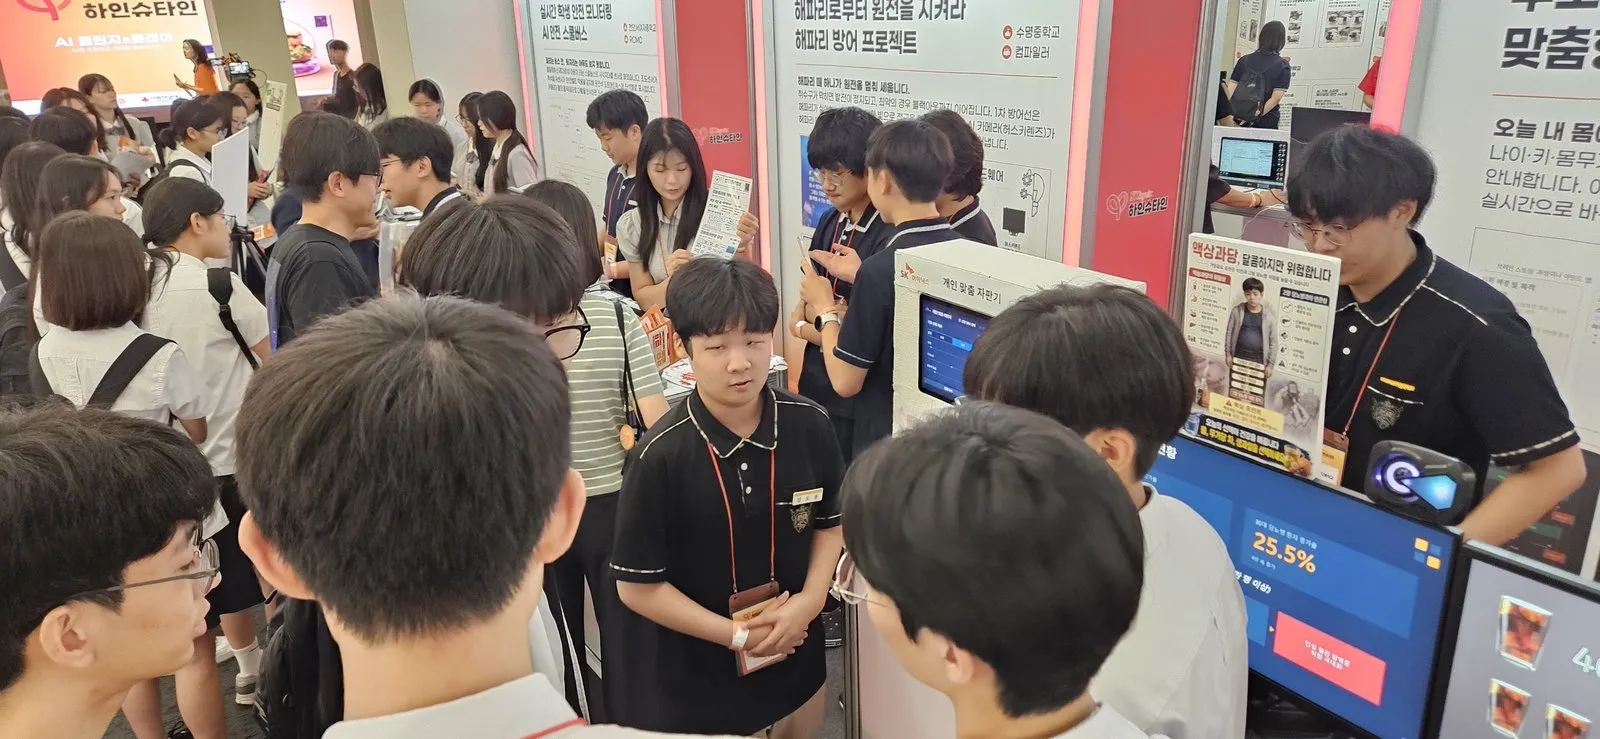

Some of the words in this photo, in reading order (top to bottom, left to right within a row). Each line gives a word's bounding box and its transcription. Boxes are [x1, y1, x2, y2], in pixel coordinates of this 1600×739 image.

[83, 0, 198, 18] 하인슈타인
[540, 4, 556, 20] 실시간
[557, 4, 571, 20] 학생
[571, 4, 584, 20] 안전
[586, 4, 612, 20] 모니터링
[795, 0, 867, 21] 해파리로부터
[872, 0, 914, 21] 원전을
[918, 0, 966, 20] 지켜라
[542, 25, 549, 40] AI
[550, 25, 560, 40] 안전
[563, 25, 588, 41] 스쿨버스
[795, 29, 829, 51] 해파리
[833, 30, 858, 52] 방어
[862, 30, 917, 54] 프로젝트
[1016, 25, 1060, 39] 수명중학교
[55, 36, 73, 48] AI
[1501, 26, 1600, 70] 맞춤
[1015, 46, 1050, 59] 컴파일러
[798, 76, 814, 86] 해파리
[824, 78, 841, 88] 하나가
[844, 79, 862, 91] 원전을
[865, 80, 878, 92] 멈춰
[880, 81, 910, 94] 세웁니다.
[899, 98, 911, 109] 경우
[954, 104, 992, 117] 이어집니다.
[995, 107, 1006, 118] 1차
[1008, 108, 1040, 121] 방어선은
[710, 133, 743, 144] 하인슈타인
[977, 121, 1055, 139] 카메라(허스키렌즈)가
[1494, 118, 1537, 139] 오늘
[1543, 121, 1565, 141] 내
[1490, 144, 1600, 168] 나이·키·몸무
[1486, 168, 1581, 193] 안내합니다.
[1129, 197, 1168, 216] 하인슈타인
[1482, 193, 1573, 217] 실시간으로
[1192, 241, 1240, 265] 액상과당,
[1242, 253, 1284, 273] 달콤하지만
[1287, 262, 1332, 282] 위험합니다
[900, 269, 909, 279] SK
[942, 277, 958, 291] 개인
[960, 282, 975, 297] 맞춤
[977, 287, 1001, 304] 자판기
[1206, 418, 1222, 431] 오늘의
[1268, 523, 1285, 536] 당뇨병
[1286, 531, 1299, 542] 환자
[1300, 536, 1317, 549] 증가율
[1253, 531, 1317, 574] 25.5%
[1252, 579, 1272, 594] 이상)
